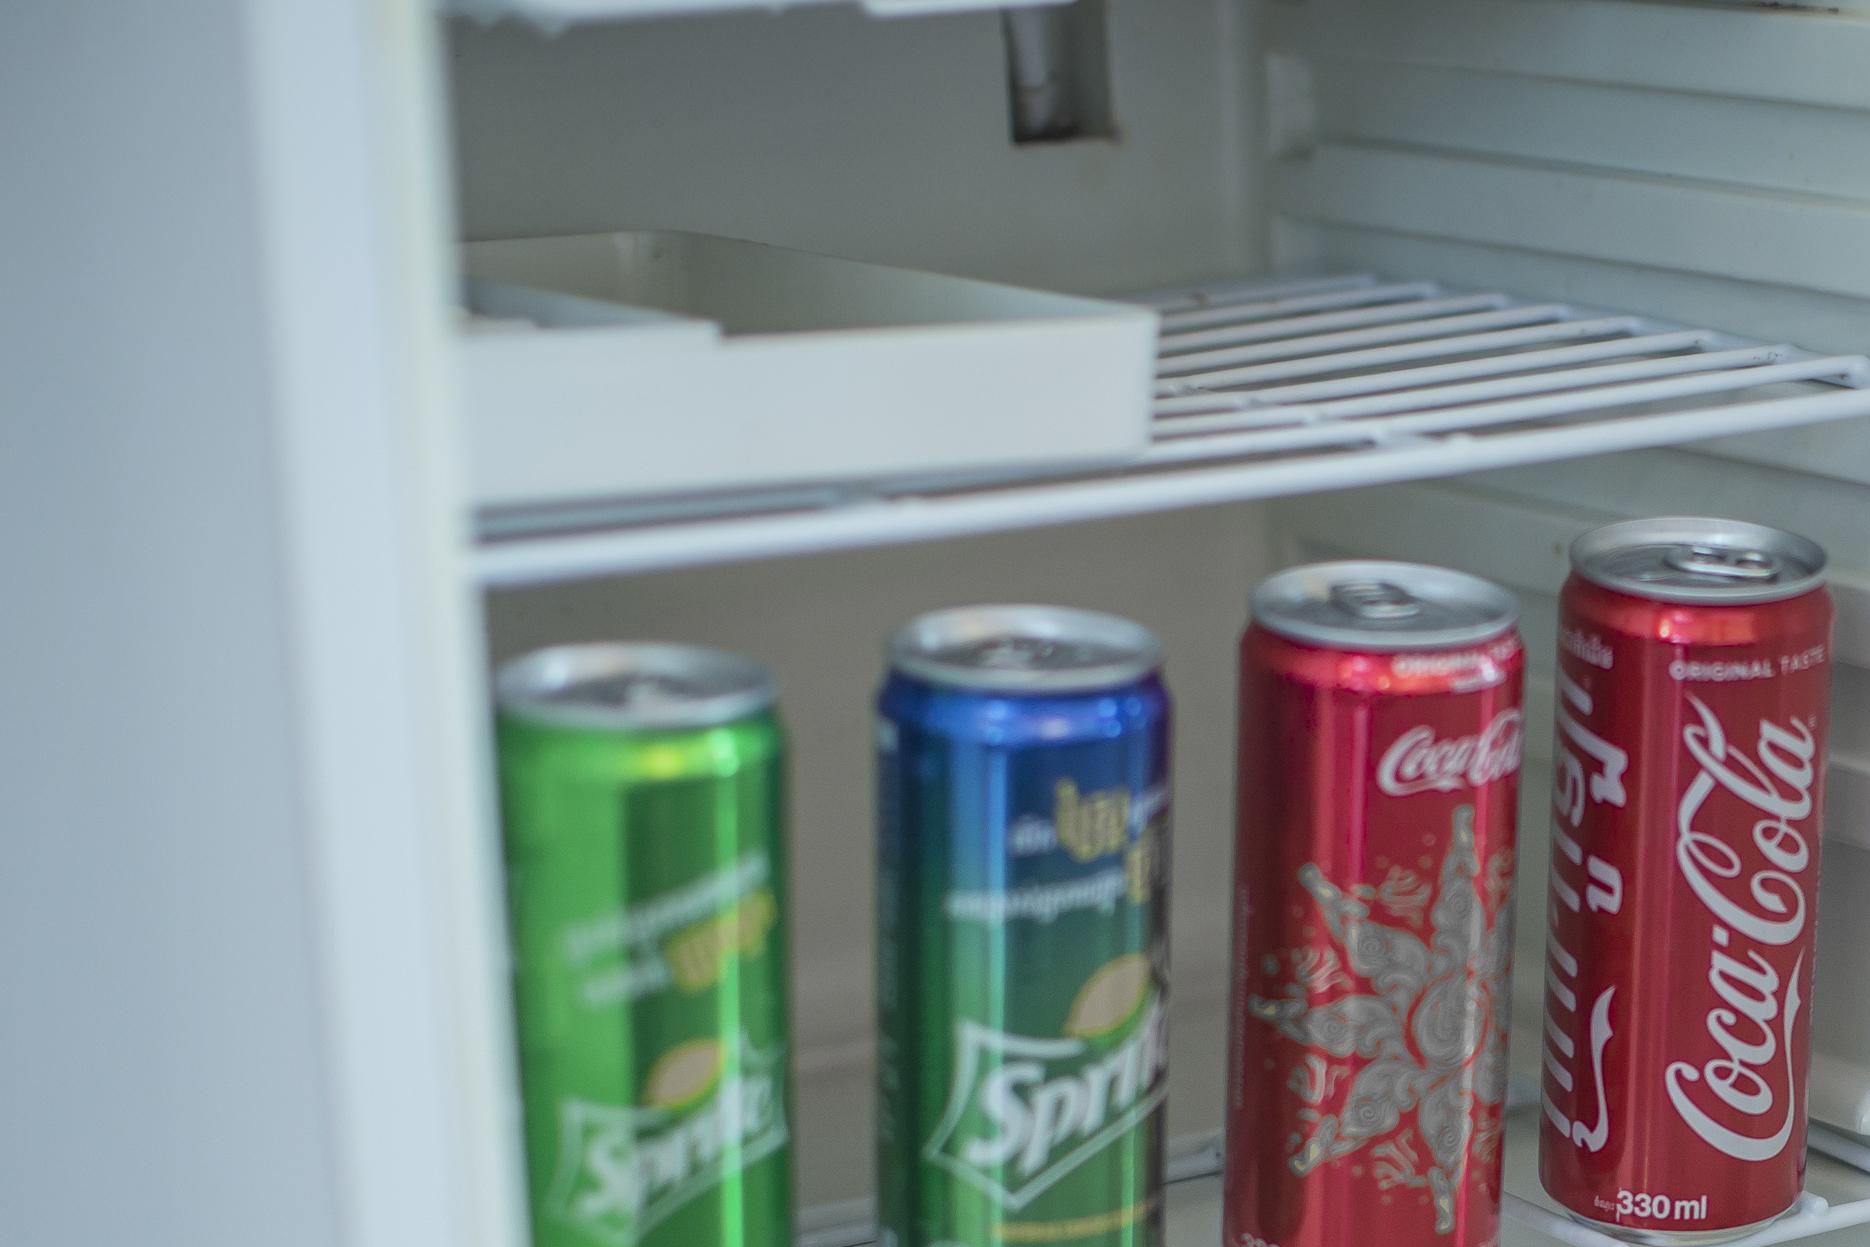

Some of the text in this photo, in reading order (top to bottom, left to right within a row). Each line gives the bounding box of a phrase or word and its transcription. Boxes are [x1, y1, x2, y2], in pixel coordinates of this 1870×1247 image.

[1669, 645, 1825, 681] ORIGINAL TASTE
[1664, 690, 1816, 1162] Coca-Cola
